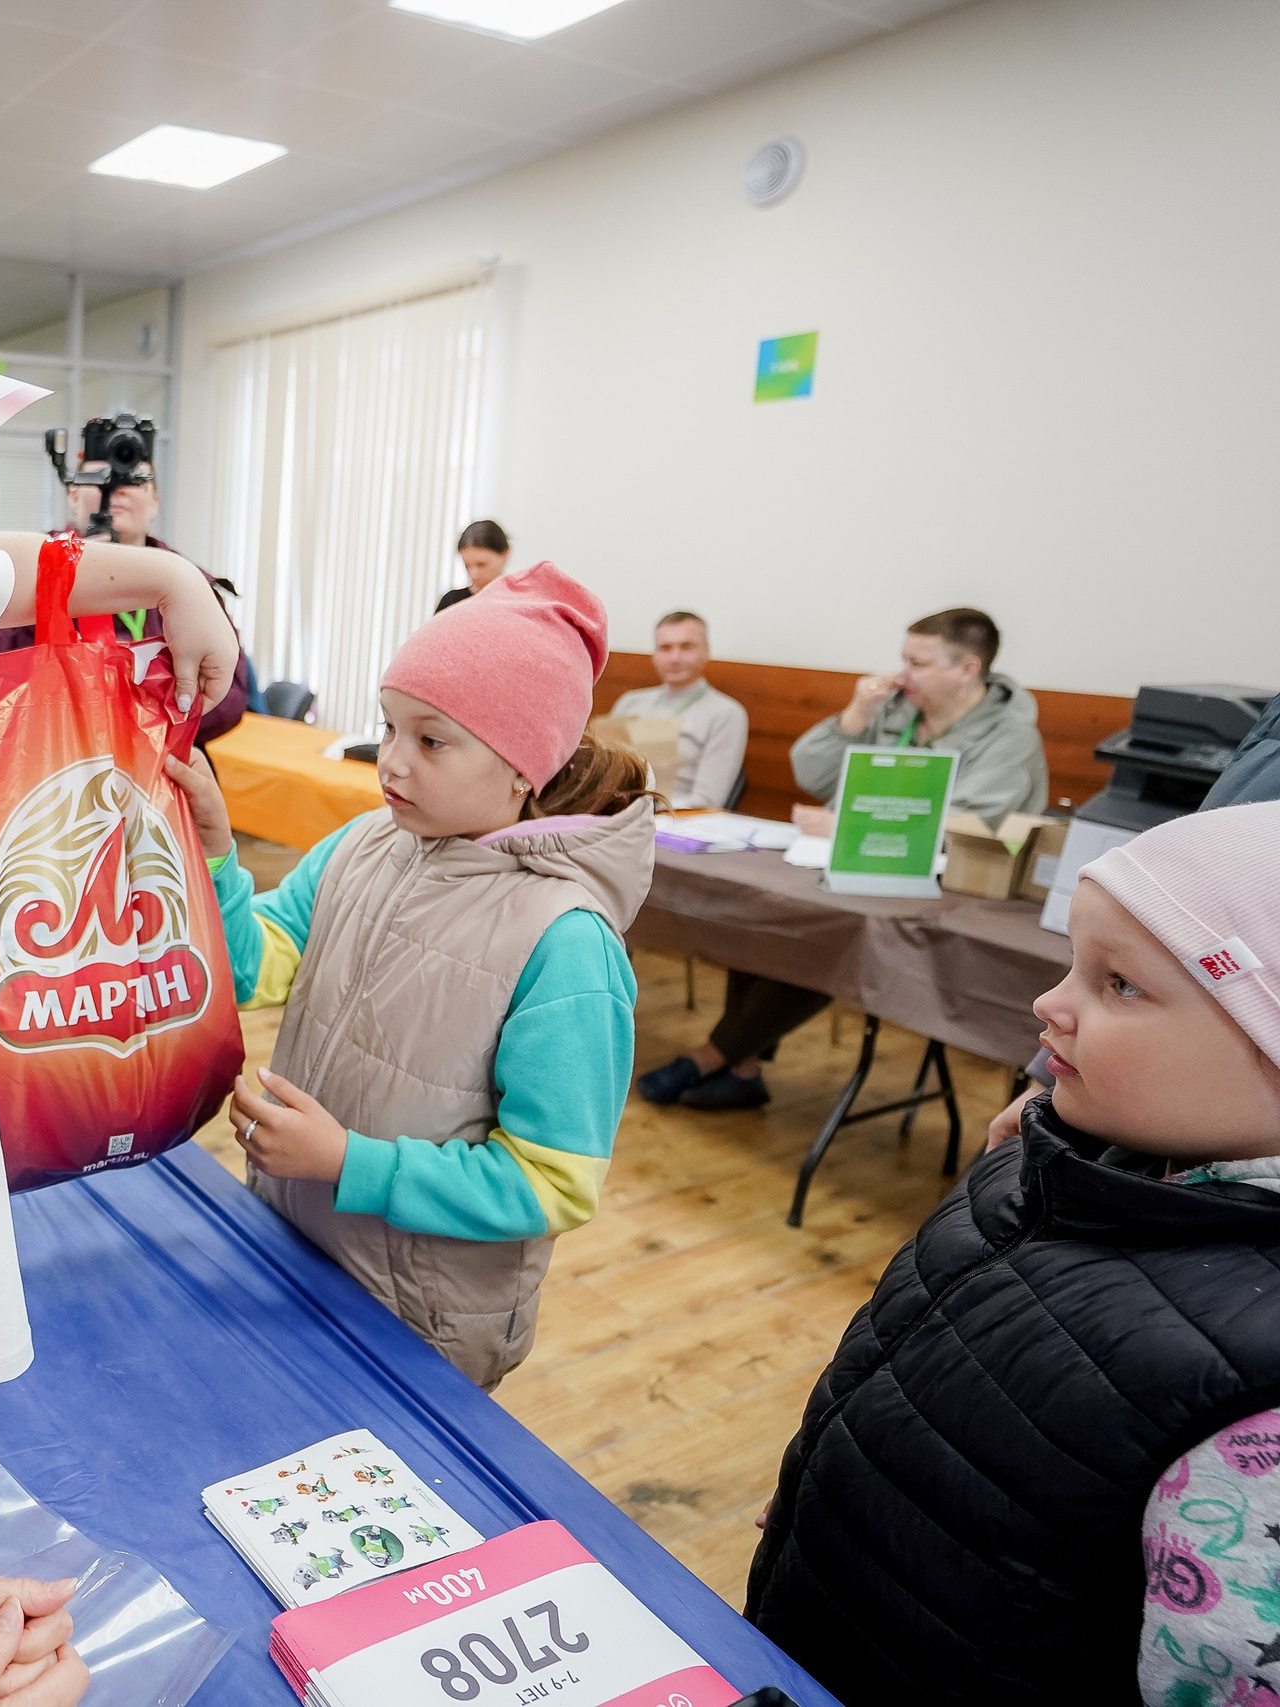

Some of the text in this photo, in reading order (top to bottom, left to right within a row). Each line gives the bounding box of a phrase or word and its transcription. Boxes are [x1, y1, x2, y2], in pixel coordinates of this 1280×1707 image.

[1199, 956, 1226, 980] GIRLS
[82, 1152, 150, 1173] martin.su
[420, 1600, 590, 1701] 2708
[515, 1670, 581, 1706] 7-9 ЛЕТ
